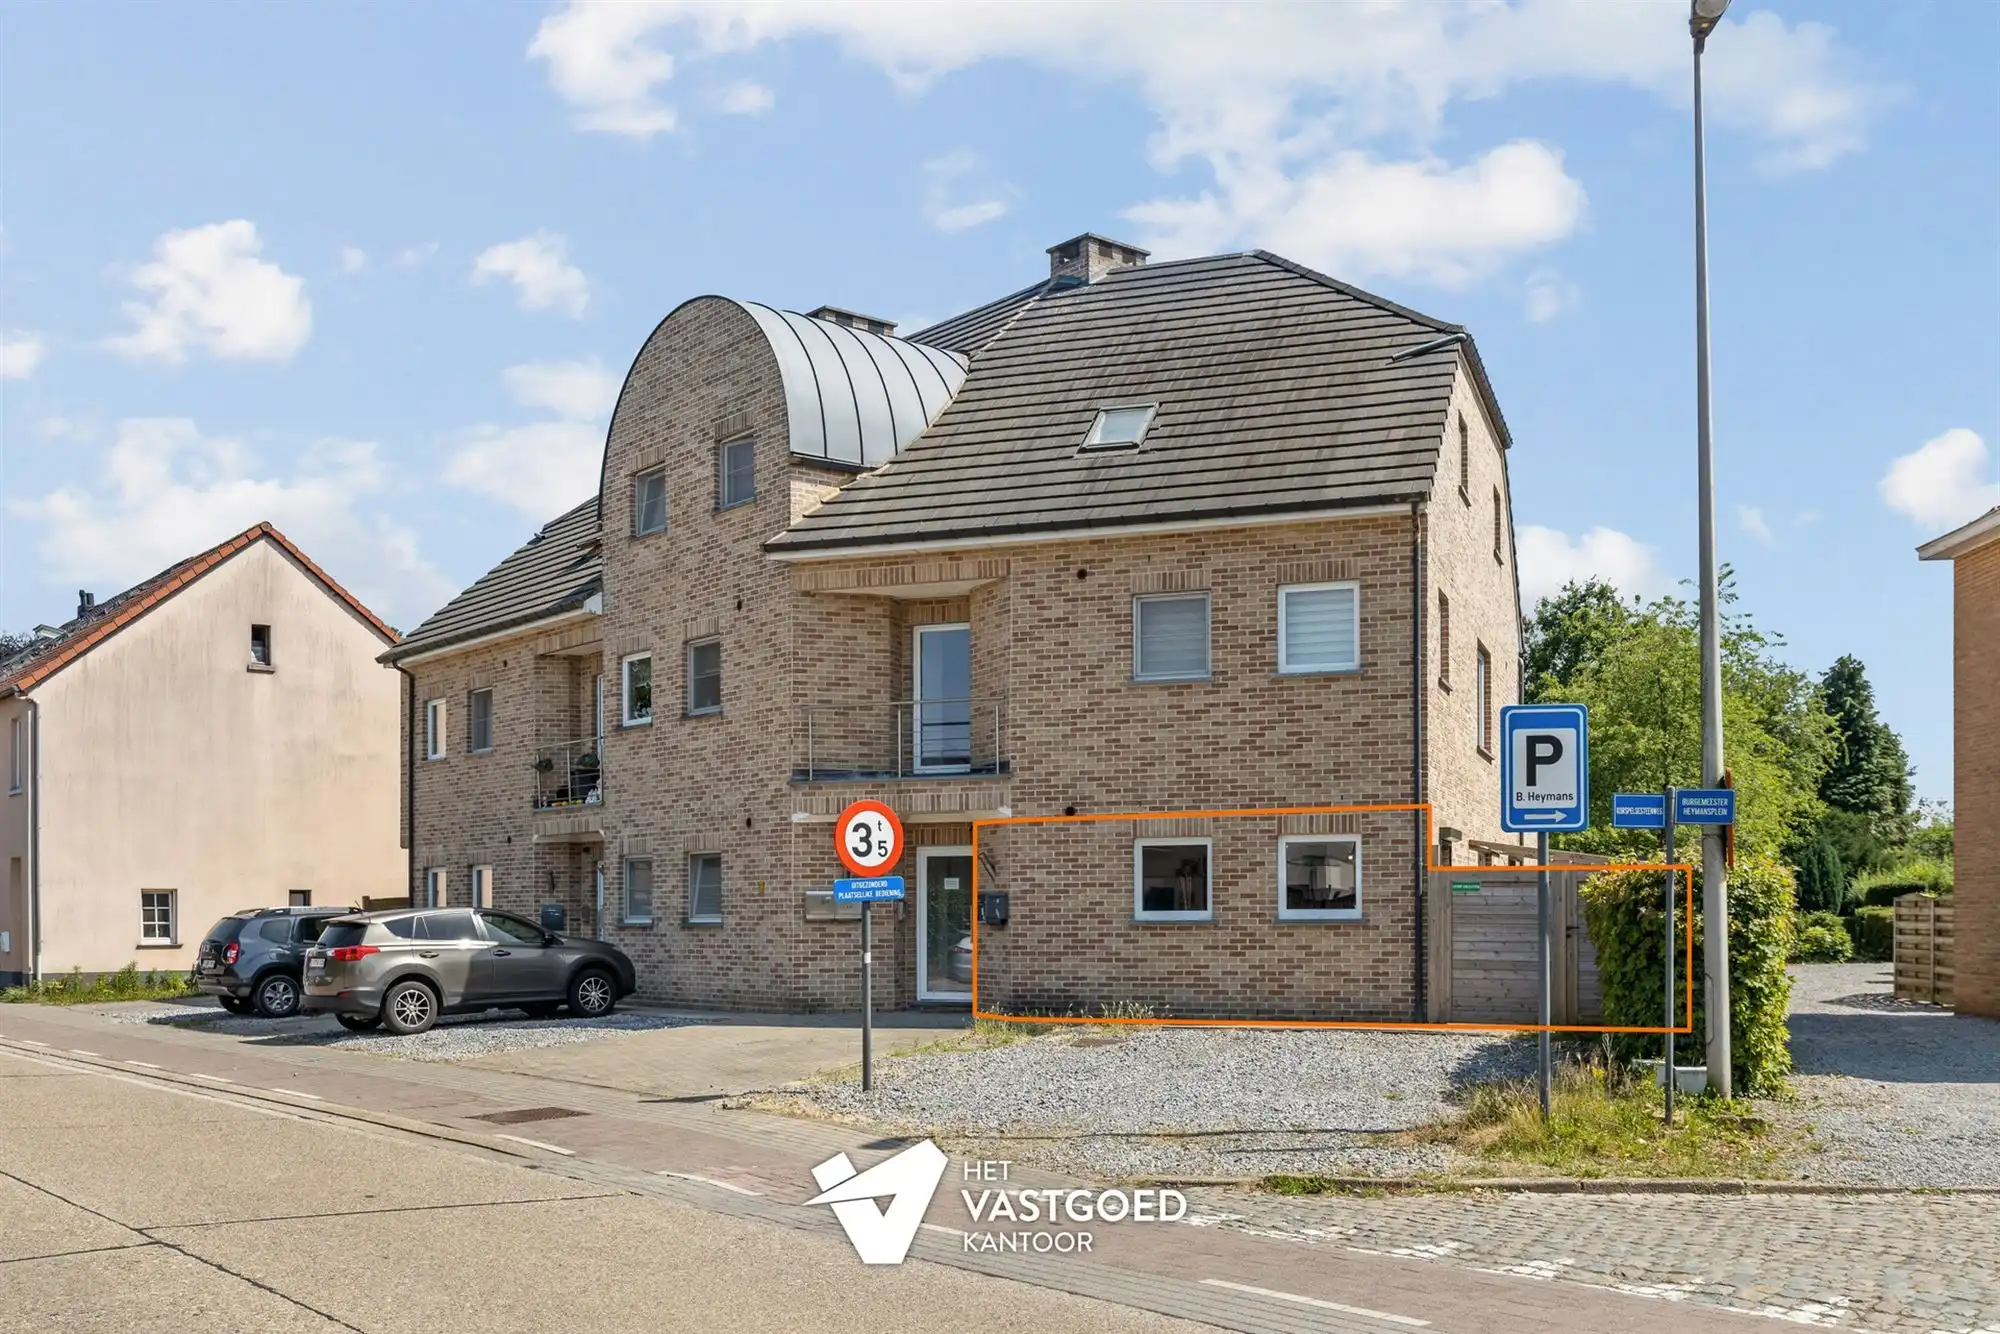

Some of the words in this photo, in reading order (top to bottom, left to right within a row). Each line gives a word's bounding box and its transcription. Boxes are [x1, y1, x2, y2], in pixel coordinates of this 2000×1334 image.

[1526, 735, 1563, 787] P
[1516, 791, 1526, 802] B.
[1528, 791, 1574, 804] Heymans
